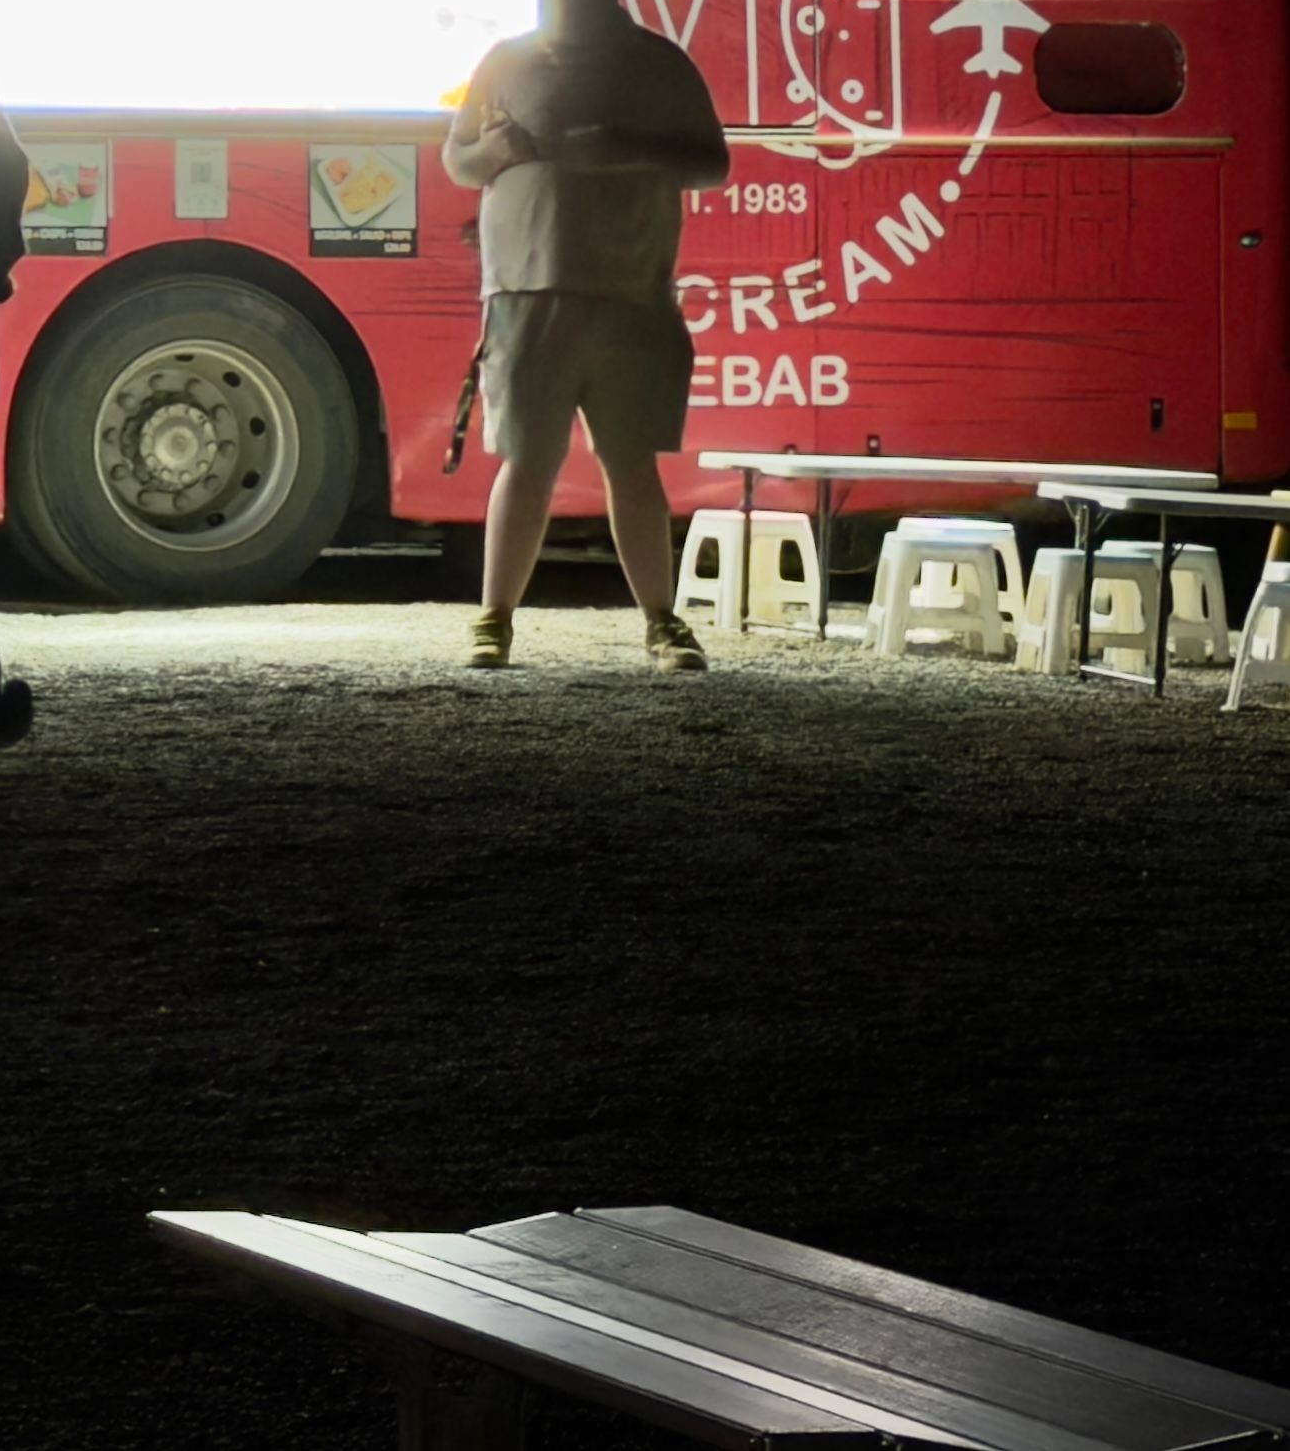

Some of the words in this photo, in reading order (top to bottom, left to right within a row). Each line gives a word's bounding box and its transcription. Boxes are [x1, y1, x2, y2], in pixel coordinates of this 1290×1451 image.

[723, 183, 808, 214] 1983
[675, 192, 946, 335] CREAM
[687, 354, 851, 408] EBAB
